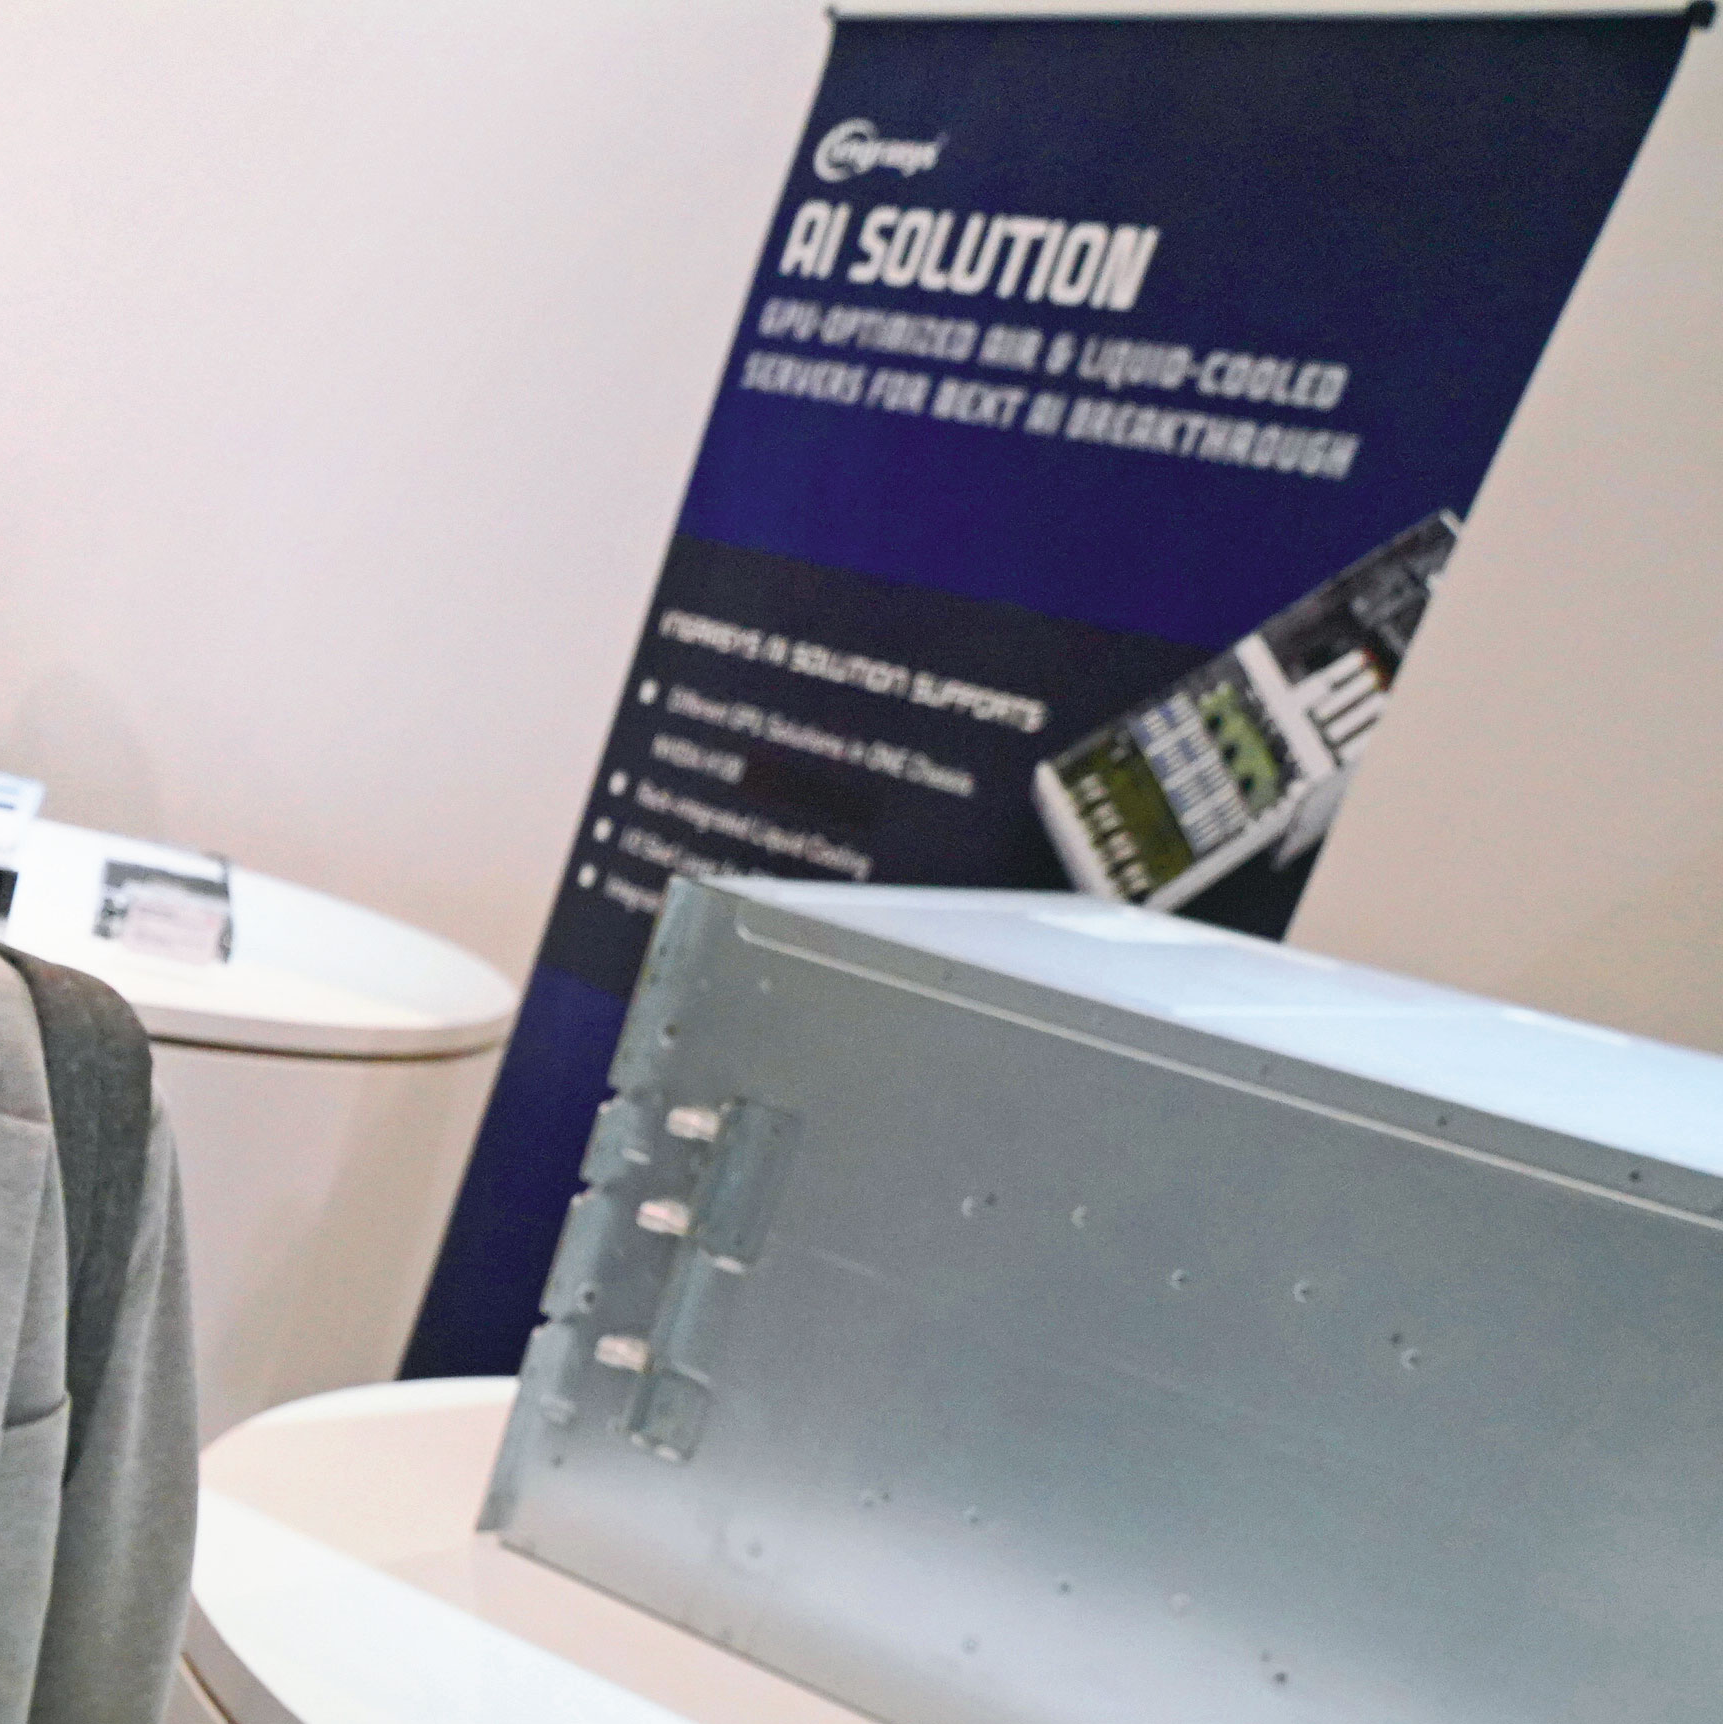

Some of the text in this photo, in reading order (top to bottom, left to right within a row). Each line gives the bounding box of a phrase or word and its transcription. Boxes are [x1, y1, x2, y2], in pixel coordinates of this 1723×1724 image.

[778, 199, 1159, 313] AI SOLUTION
[740, 351, 1361, 482] SERVERS FOR NEXT AI BREAKTHROUGH
[1077, 334, 1351, 412] LIQUID-COOLED
[789, 640, 912, 698] SOLUTION
[909, 671, 1048, 734] SUPPORTS
